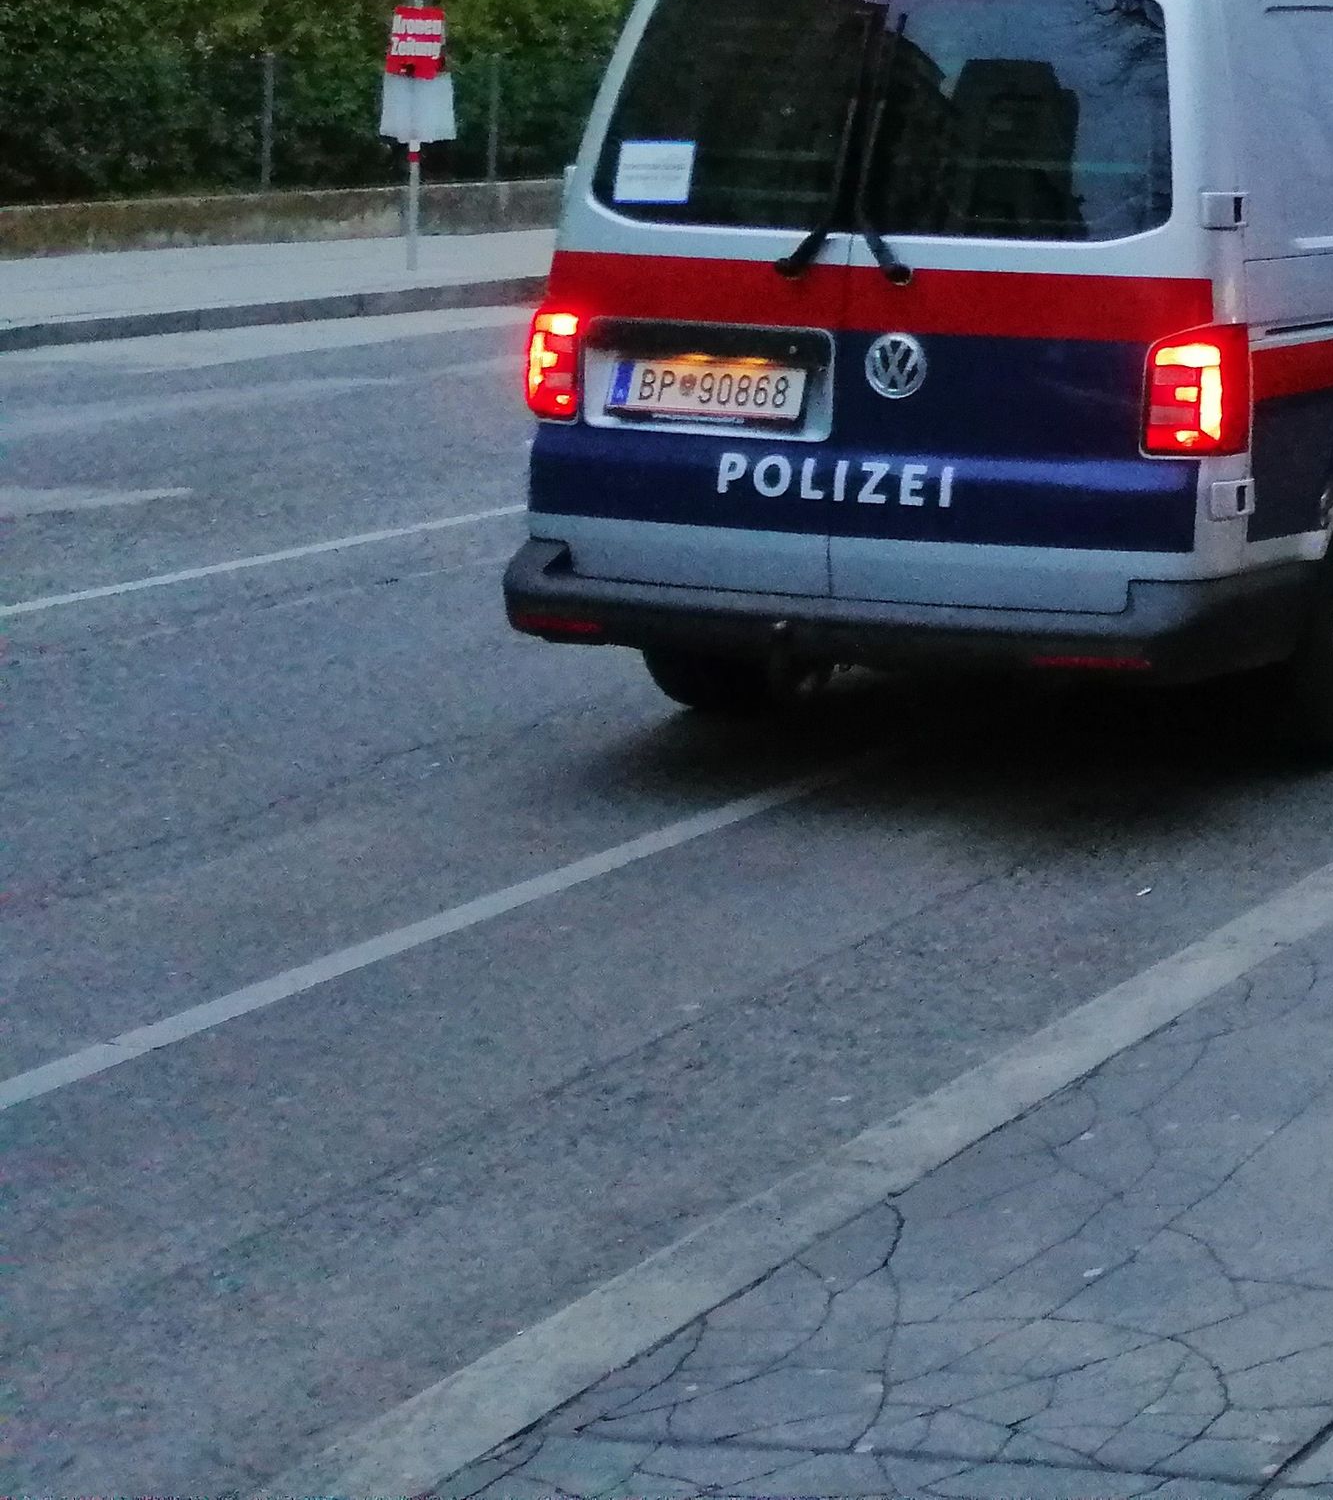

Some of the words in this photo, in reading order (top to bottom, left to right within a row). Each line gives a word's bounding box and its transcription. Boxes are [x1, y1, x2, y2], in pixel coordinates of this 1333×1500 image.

[638, 368, 676, 402] BP
[698, 373, 789, 409] 90868
[717, 452, 954, 508] POLIZEI
